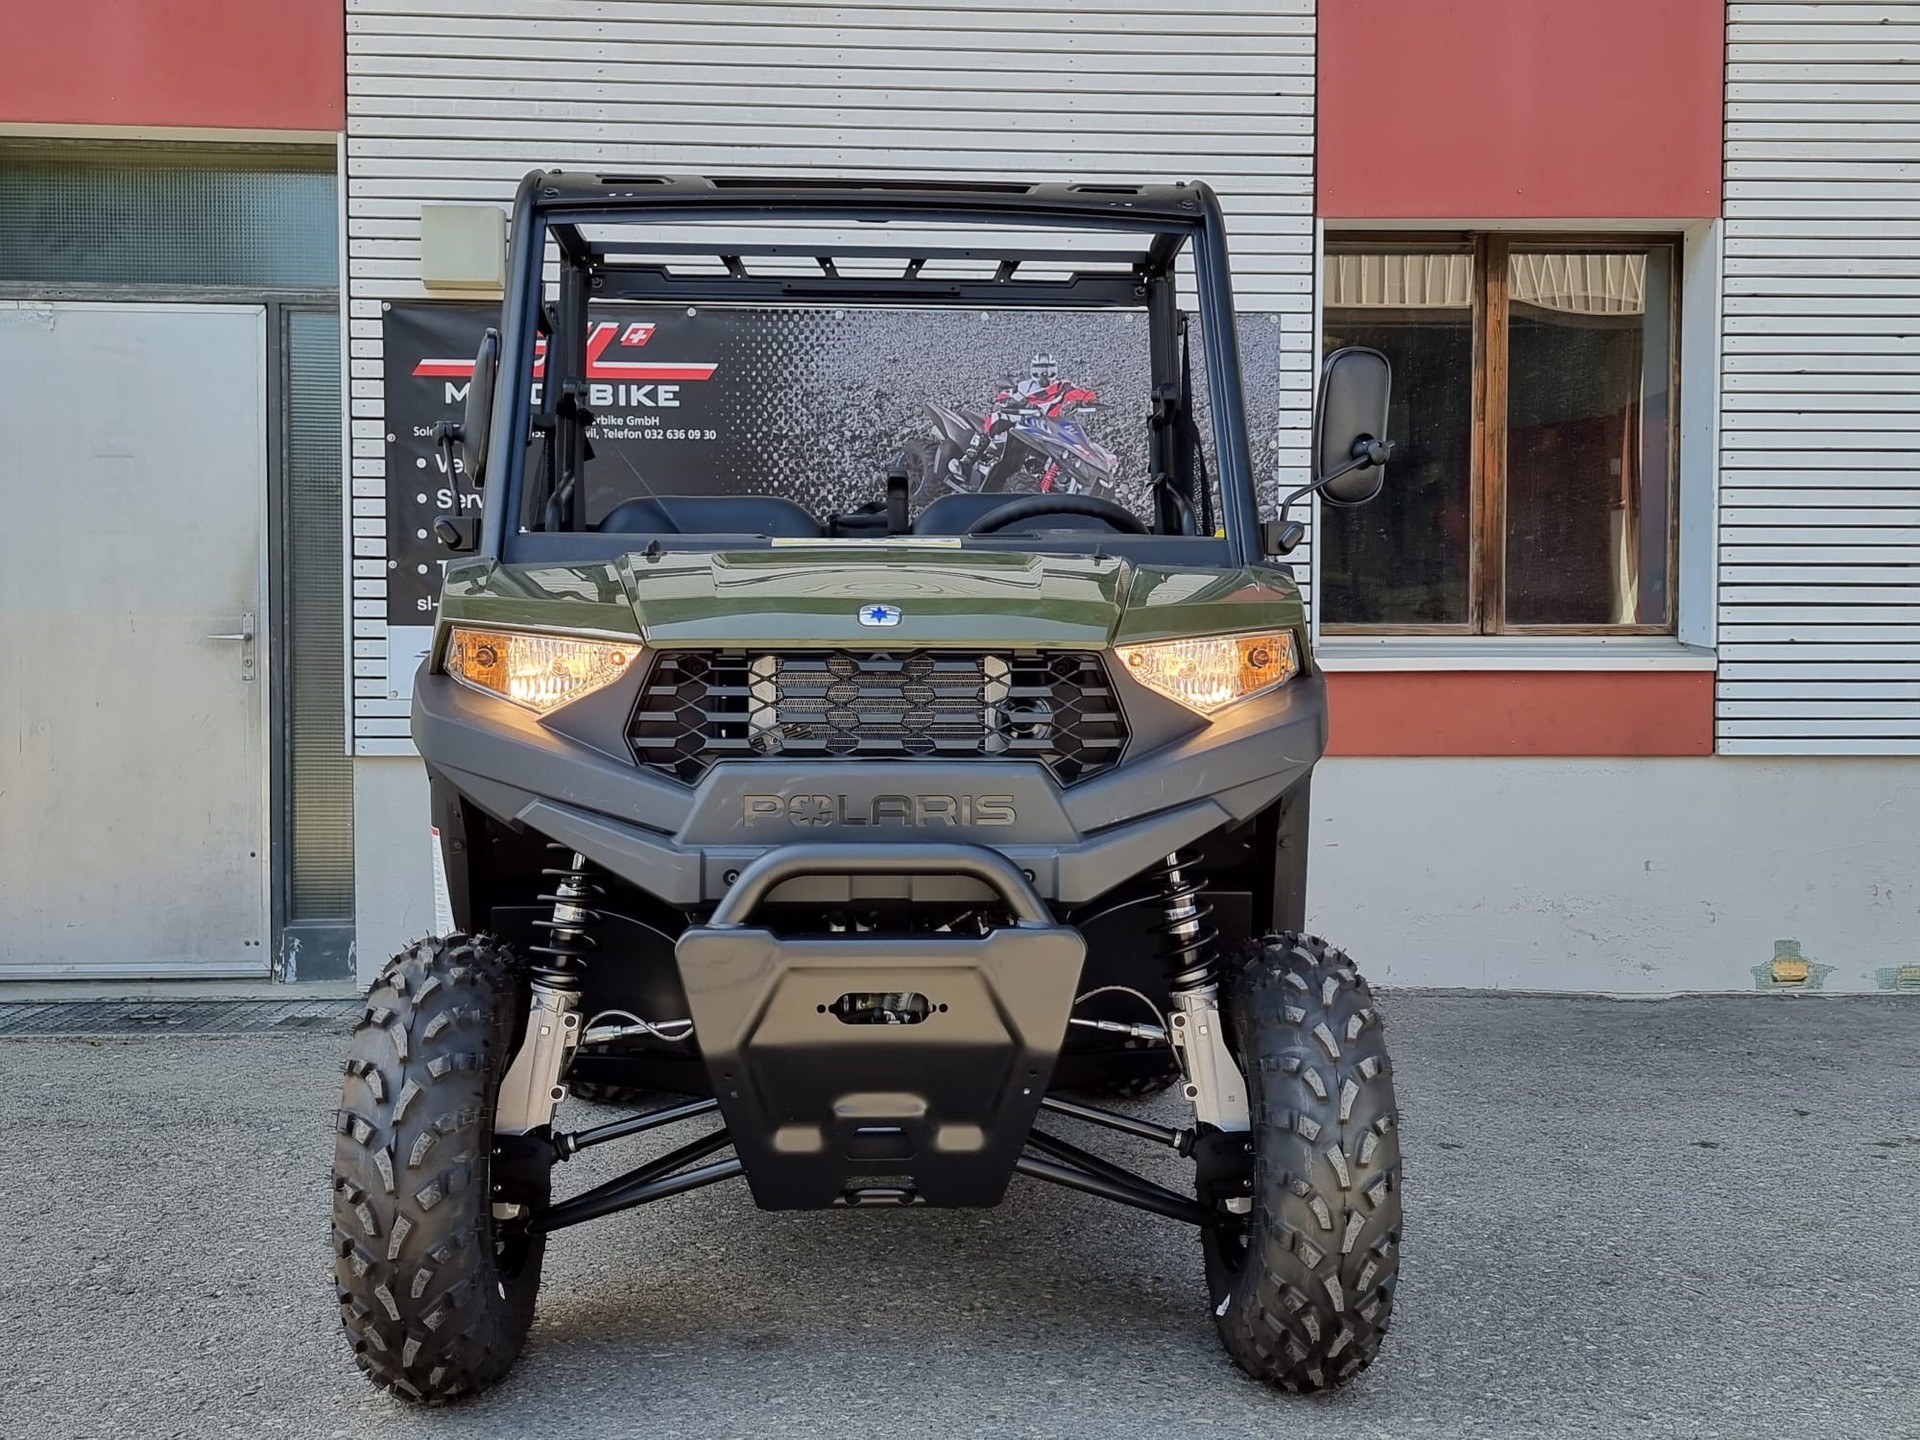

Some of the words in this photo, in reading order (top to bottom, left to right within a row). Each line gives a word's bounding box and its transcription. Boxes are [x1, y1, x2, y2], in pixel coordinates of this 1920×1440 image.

[626, 415, 660, 427] GmbH
[602, 428, 642, 440] Telefon
[644, 429, 664, 440] 032
[666, 429, 685, 440] 636
[687, 429, 701, 440] 09
[703, 429, 717, 440] 30
[742, 794, 1018, 827] POLARIS
